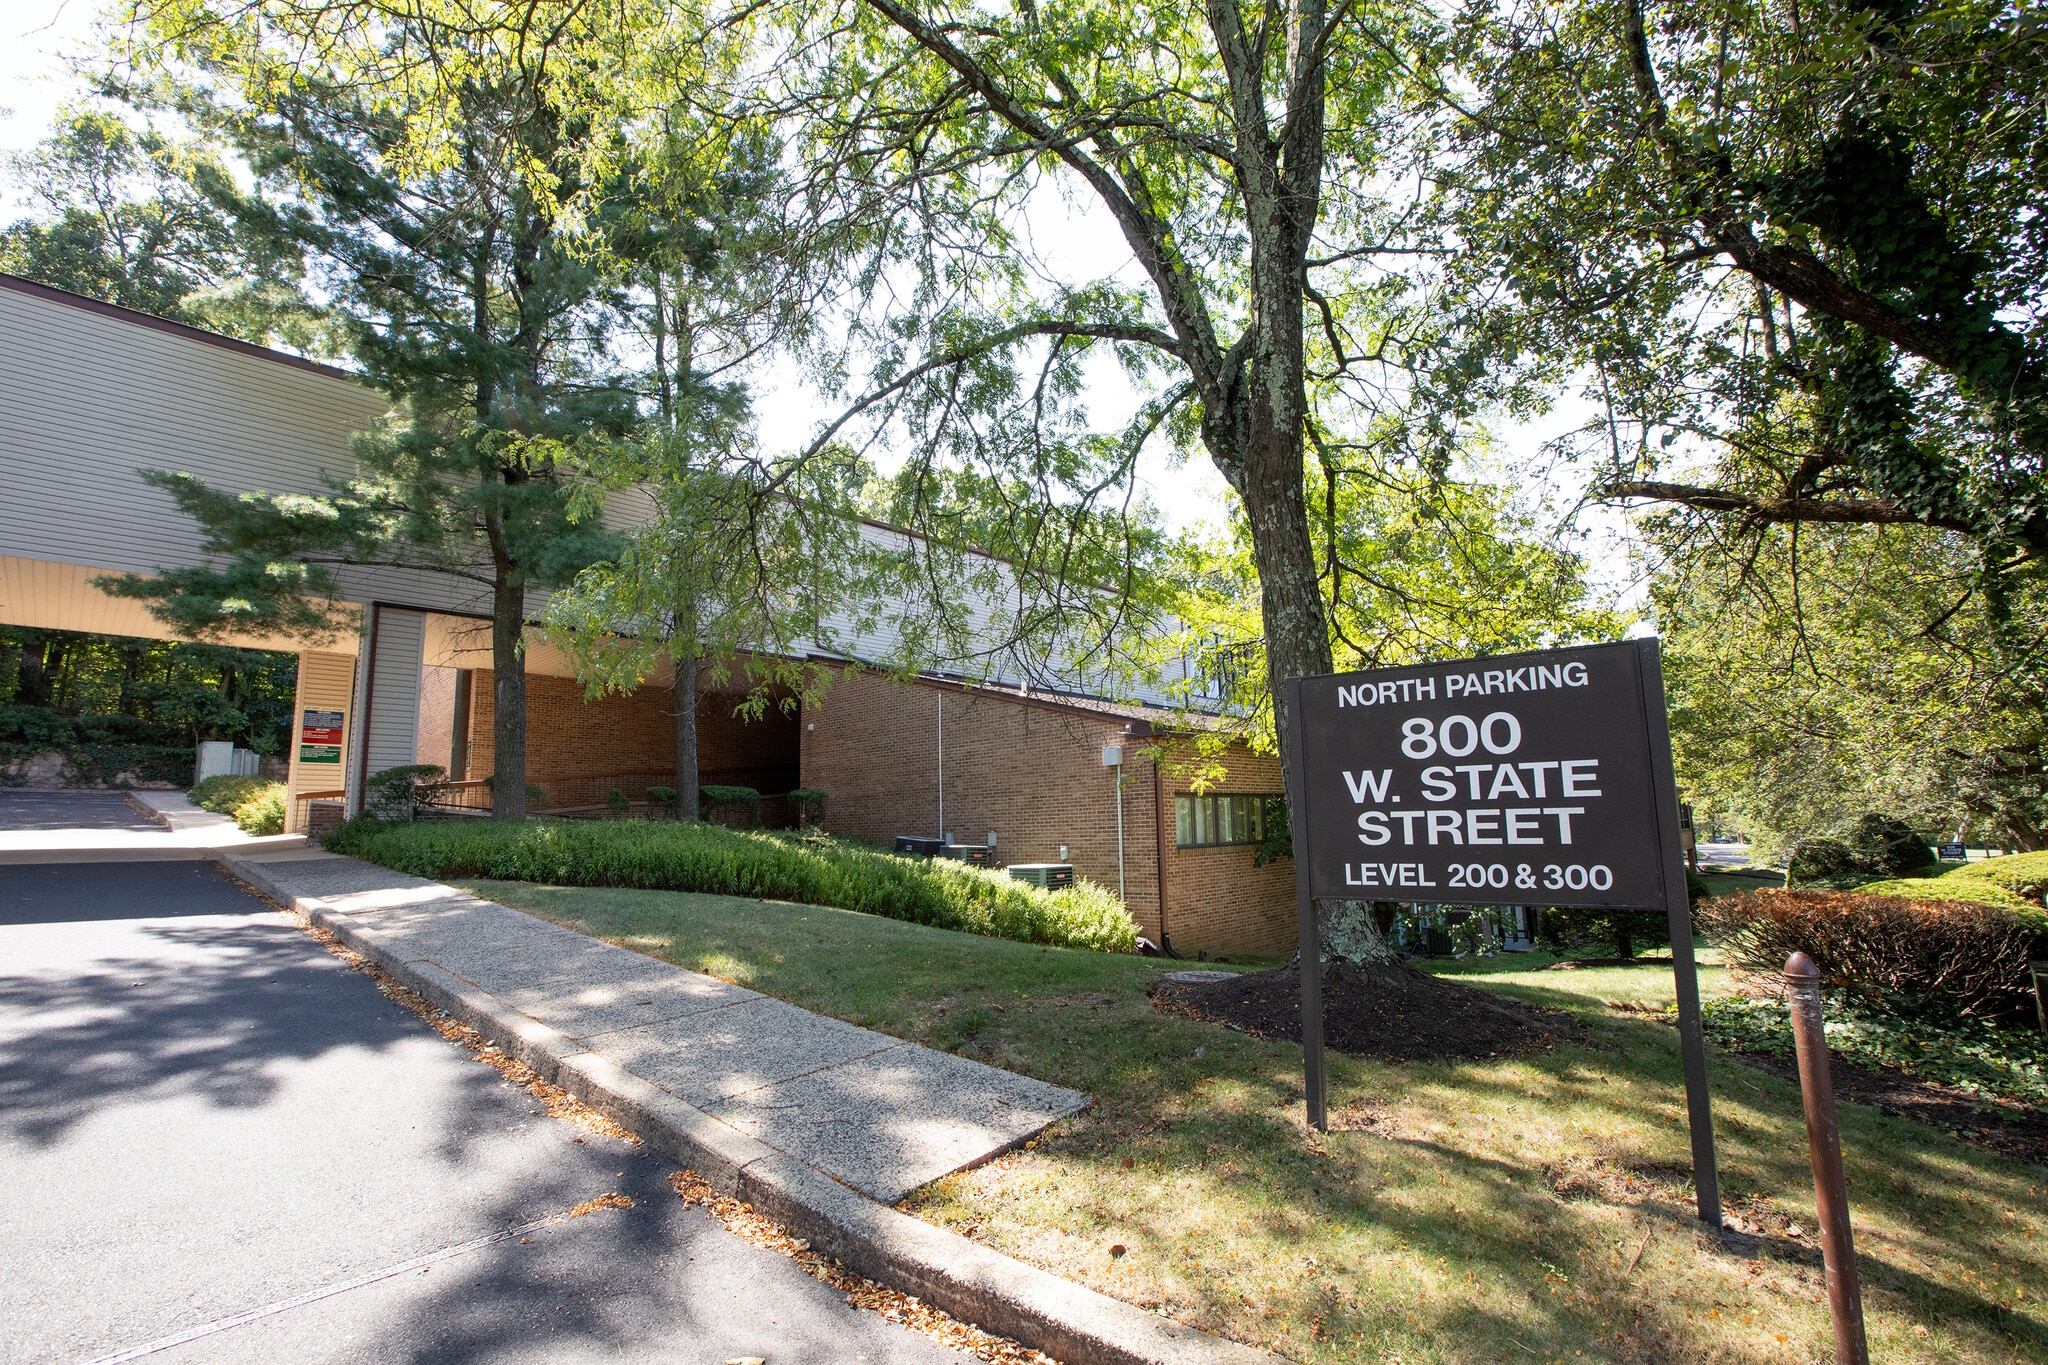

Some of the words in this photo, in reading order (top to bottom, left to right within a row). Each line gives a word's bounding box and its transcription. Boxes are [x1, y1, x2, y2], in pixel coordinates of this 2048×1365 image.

[1338, 678, 1435, 707] NORTH
[1446, 662, 1589, 698] PARKING
[1401, 712, 1521, 759] 800
[1342, 769, 1400, 803] W.
[1421, 759, 1602, 802] STATE
[1358, 807, 1585, 846] STREET
[1345, 863, 1436, 886] LEVEL
[1448, 863, 1508, 888] 200
[1515, 864, 1537, 889] &
[1543, 864, 1613, 890] 300
